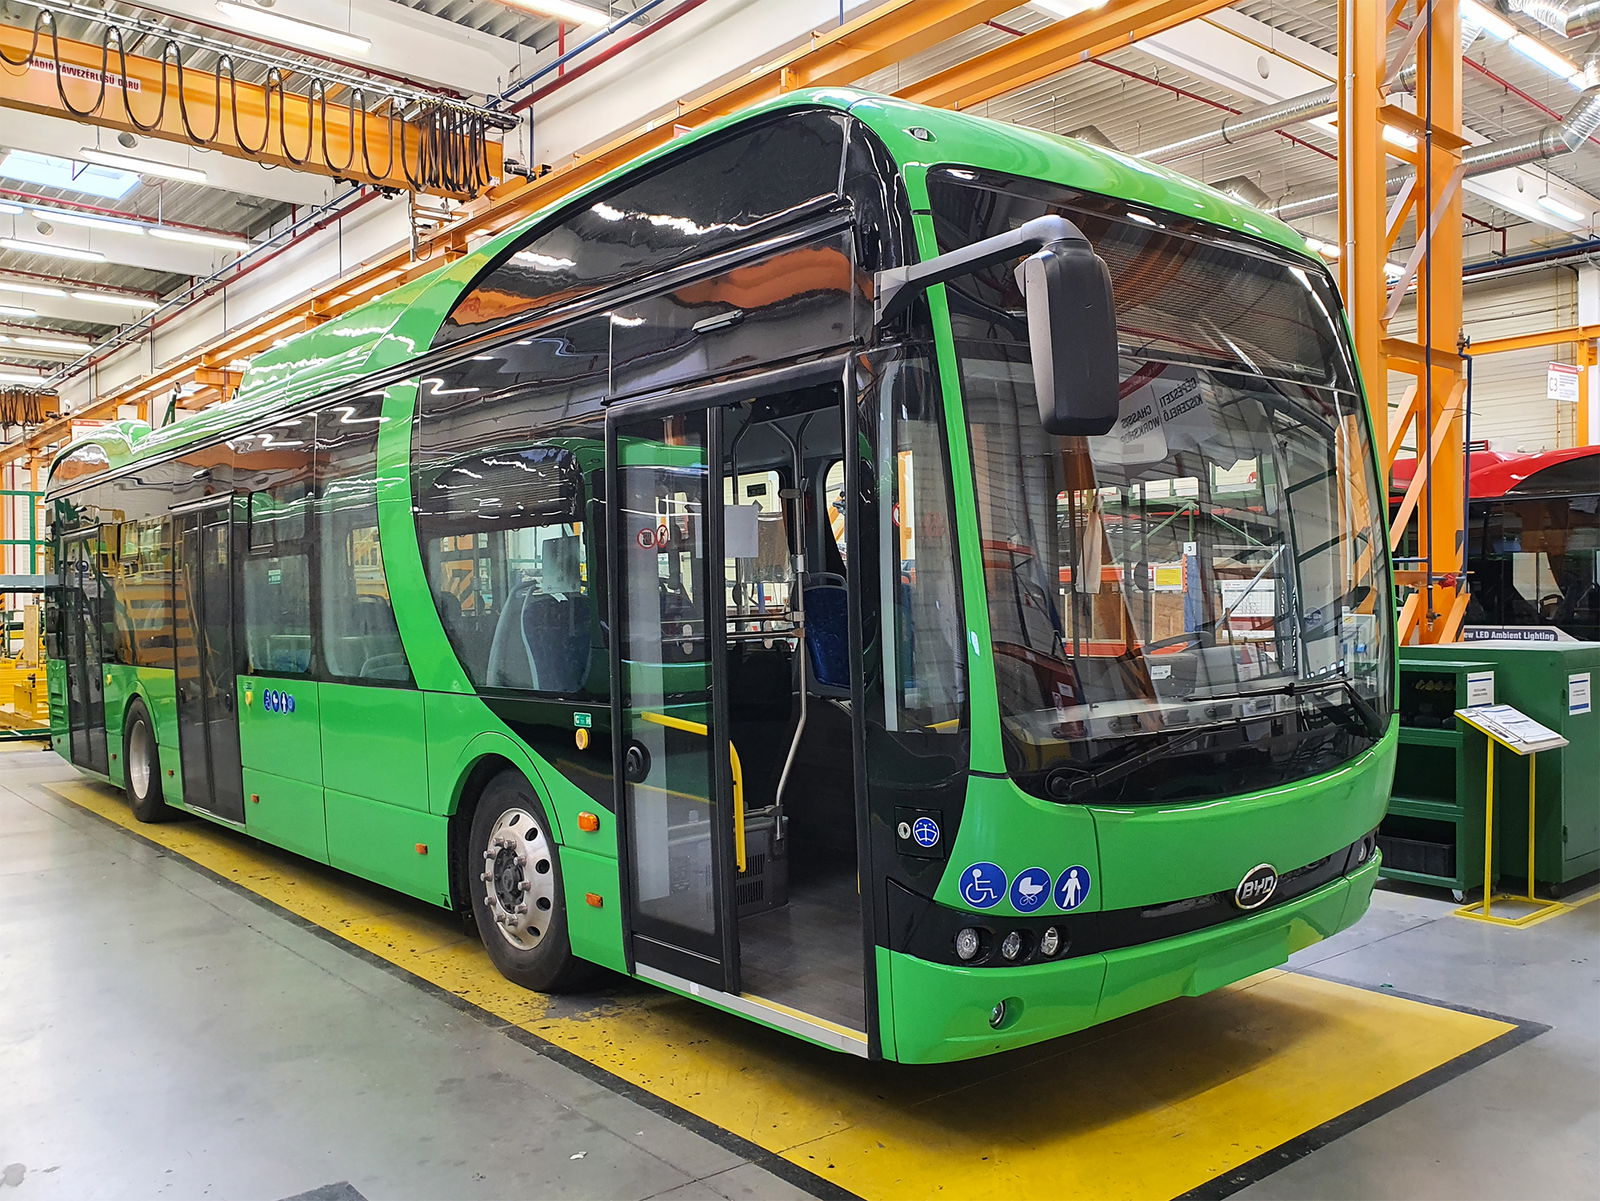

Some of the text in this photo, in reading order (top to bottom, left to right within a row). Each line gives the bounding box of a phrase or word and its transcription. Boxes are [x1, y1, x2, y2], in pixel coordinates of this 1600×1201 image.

[57, 63, 115, 86] ÁVVEZÉRLSŰ
[1475, 631, 1489, 639] LED
[1491, 631, 1521, 639] Ambient
[1523, 632, 1555, 641] Lighting
[1241, 876, 1274, 900] BYD
